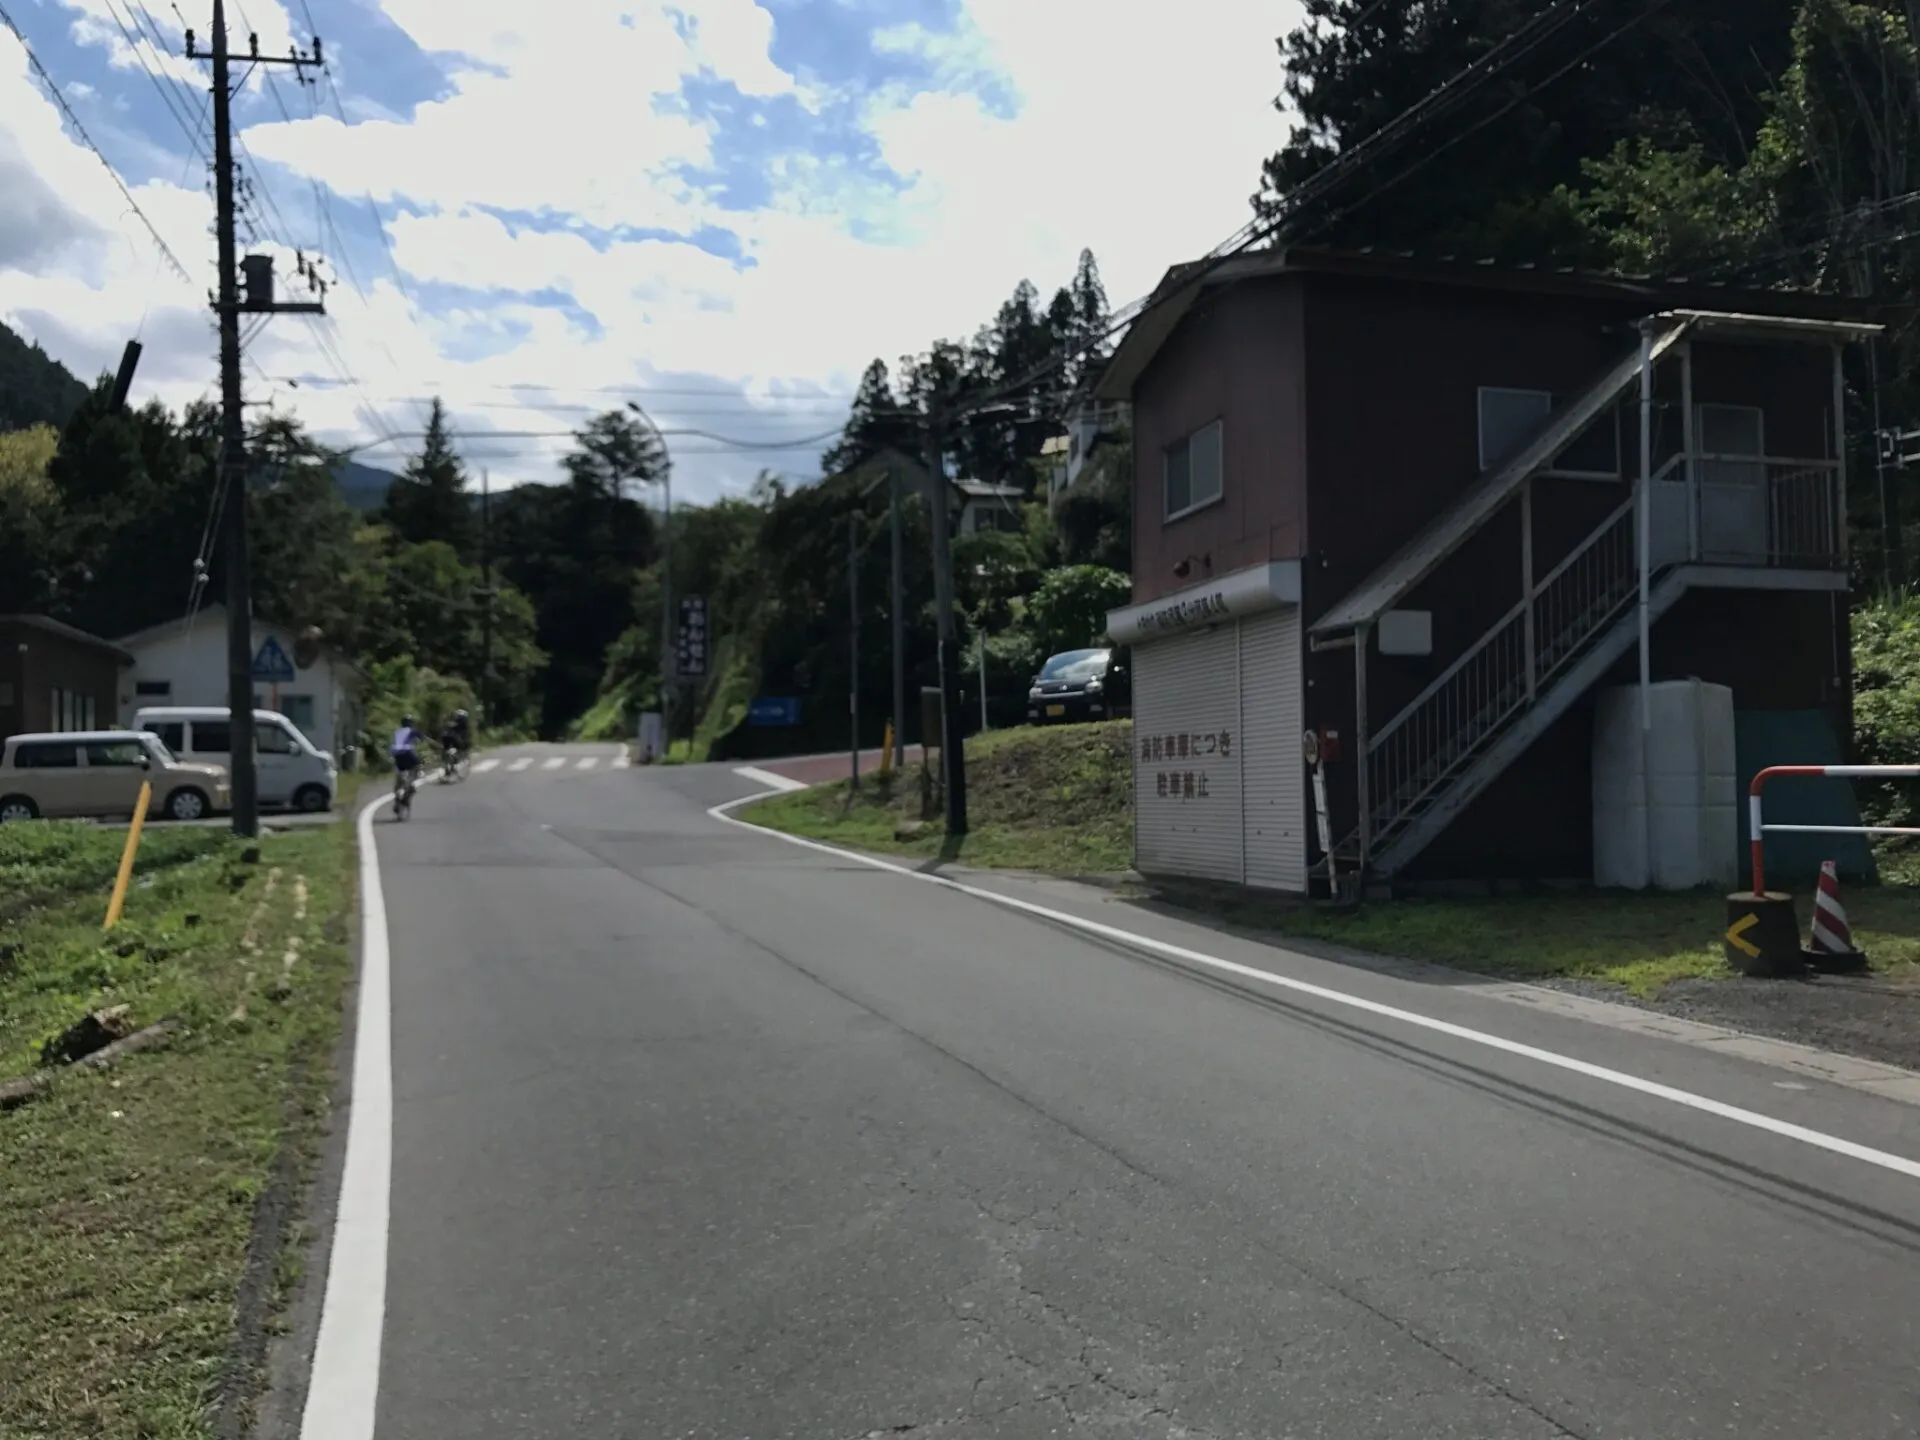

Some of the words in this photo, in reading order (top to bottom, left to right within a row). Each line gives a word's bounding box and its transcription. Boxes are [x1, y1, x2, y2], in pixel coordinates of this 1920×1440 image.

[1141, 730, 1232, 762] 消防車庫につき
[1156, 771, 1210, 800] 駐車禁止
